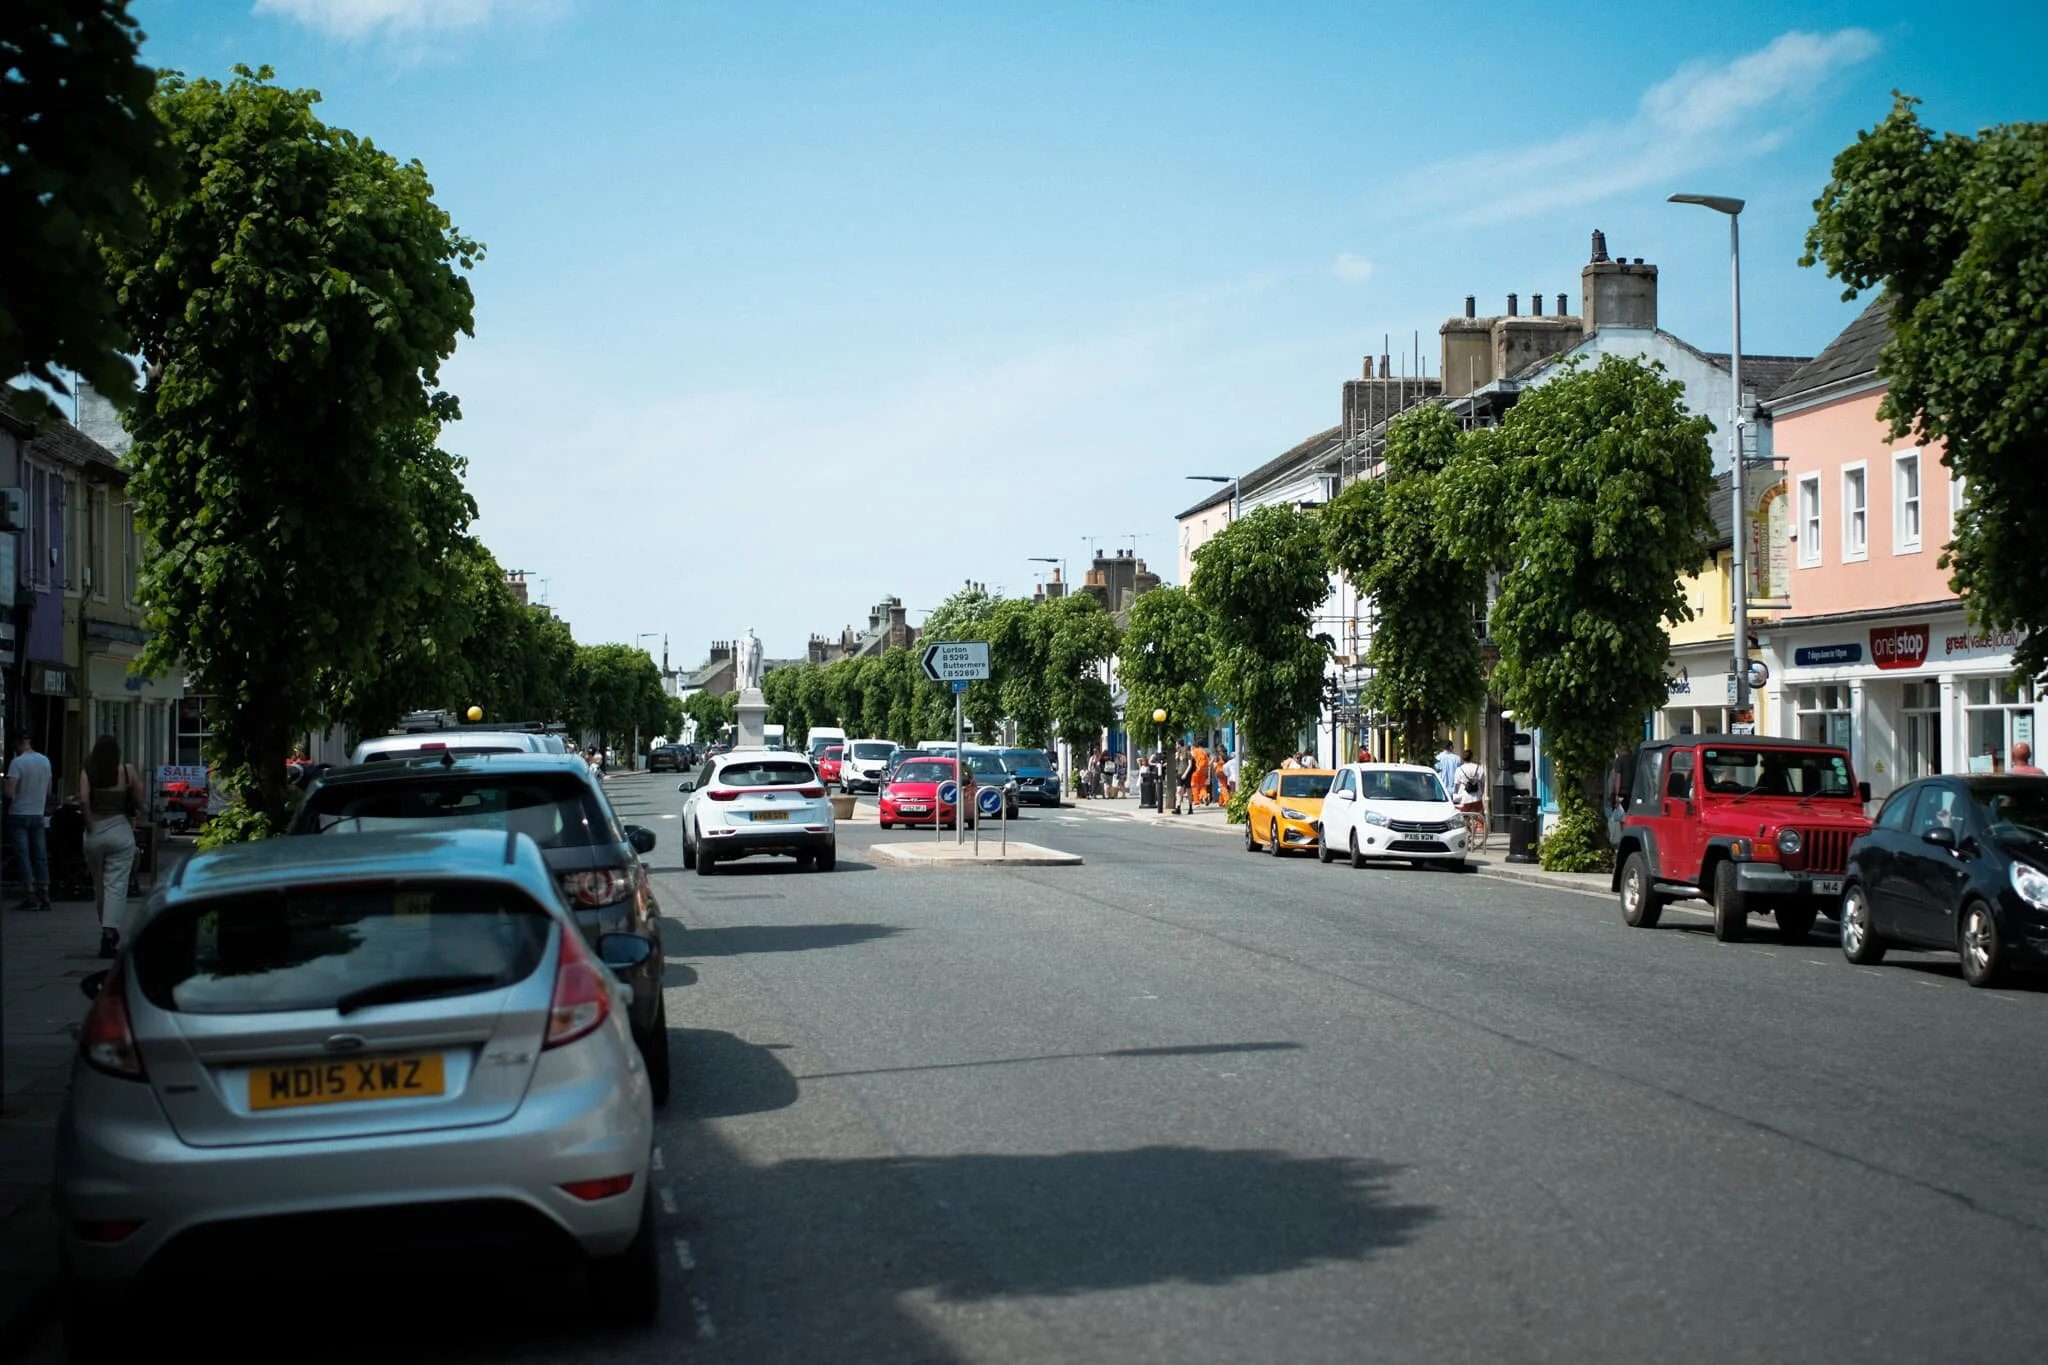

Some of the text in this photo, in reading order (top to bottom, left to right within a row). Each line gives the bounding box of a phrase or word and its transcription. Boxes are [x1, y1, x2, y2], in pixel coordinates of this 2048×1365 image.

[1874, 632, 1923, 660] one stop
[1946, 633, 1967, 655] great
[163, 766, 200, 776] SALE
[270, 1060, 422, 1099] MD15 XWZ
